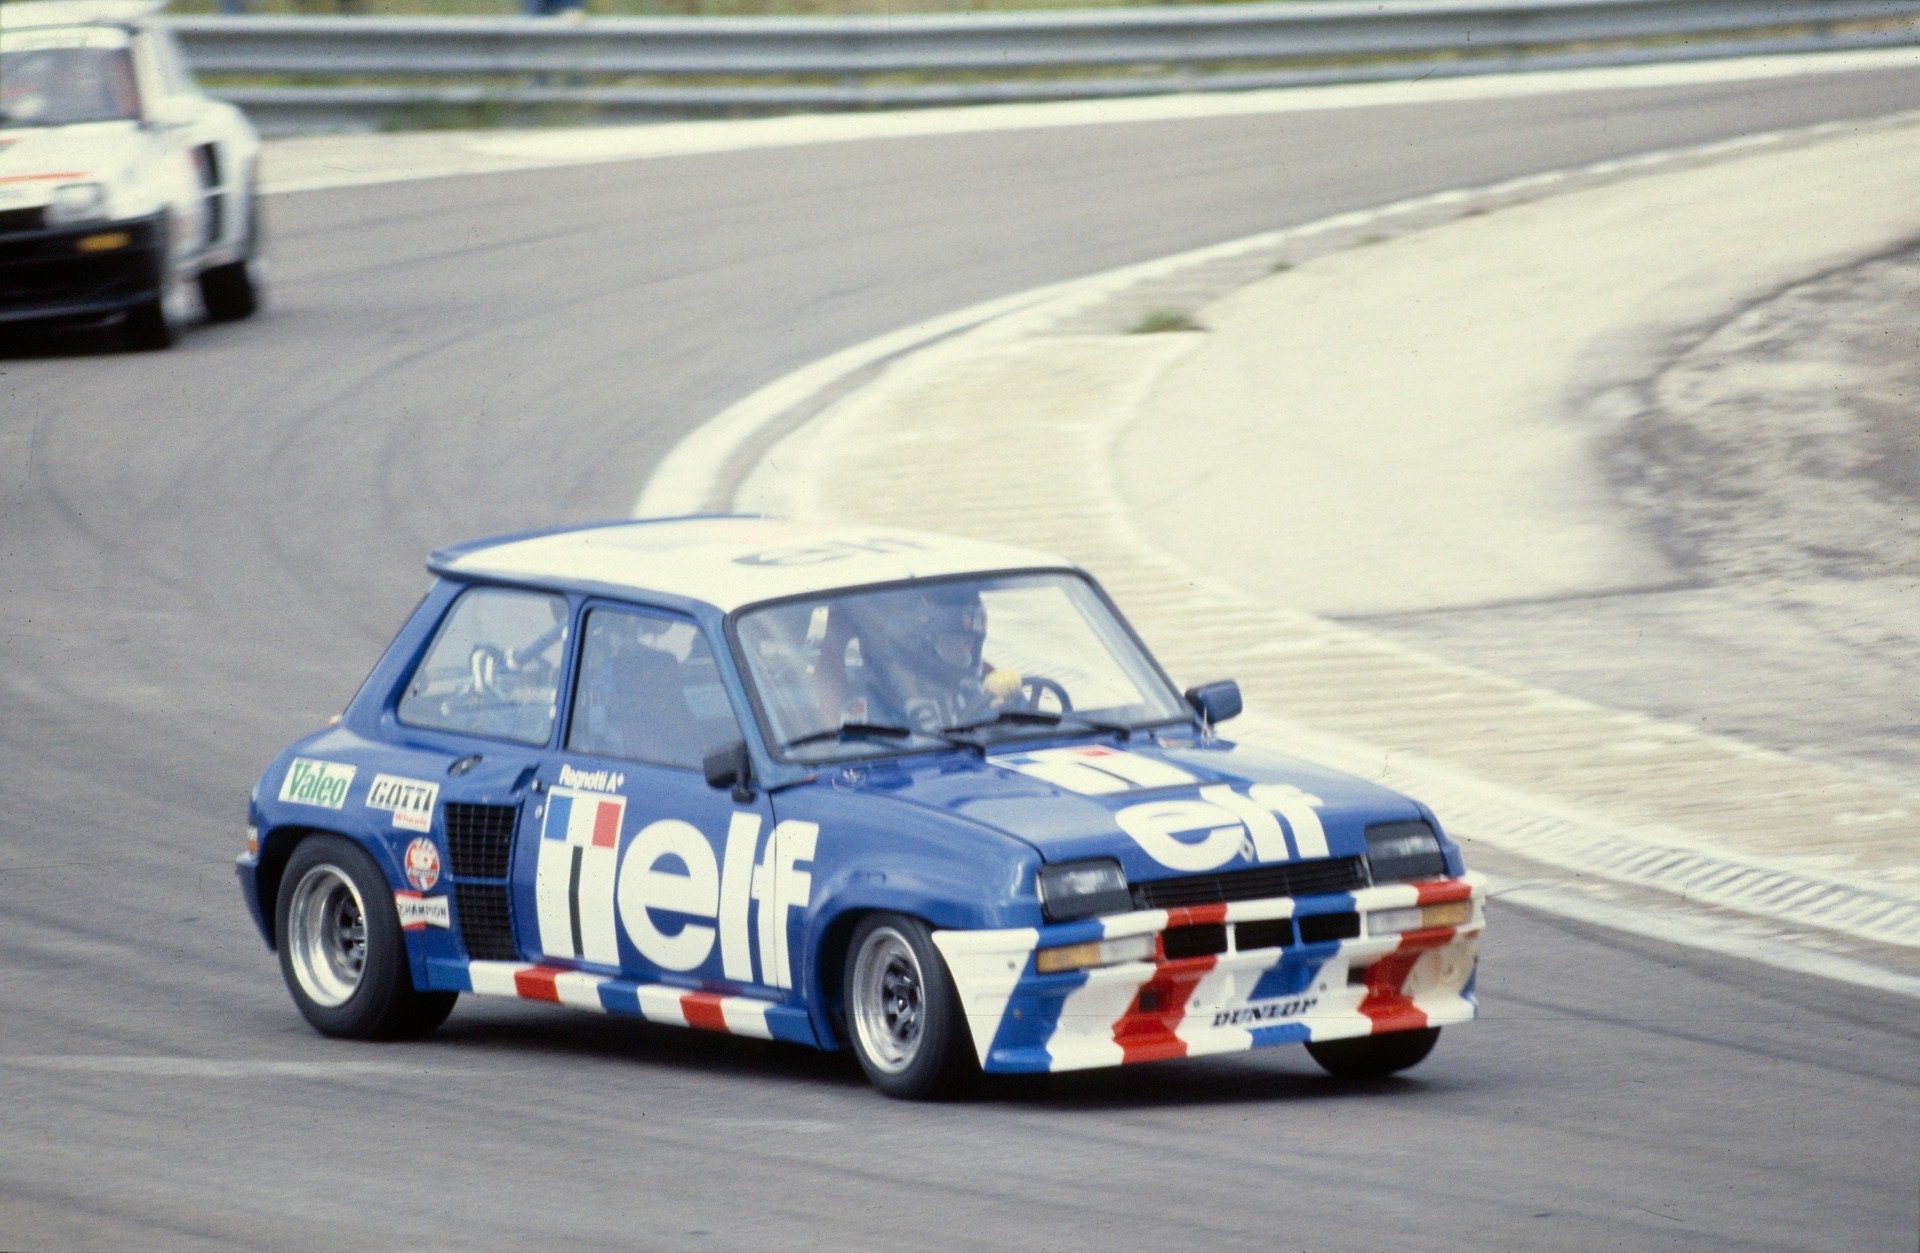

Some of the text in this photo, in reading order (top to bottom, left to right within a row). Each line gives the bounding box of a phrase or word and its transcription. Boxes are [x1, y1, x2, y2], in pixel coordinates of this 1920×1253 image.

[288, 762, 348, 804] Valeo
[370, 782, 433, 811] GOTTI
[1115, 784, 1329, 872] elf
[617, 811, 819, 990] elf
[1212, 998, 1318, 1026] DUNLOP
